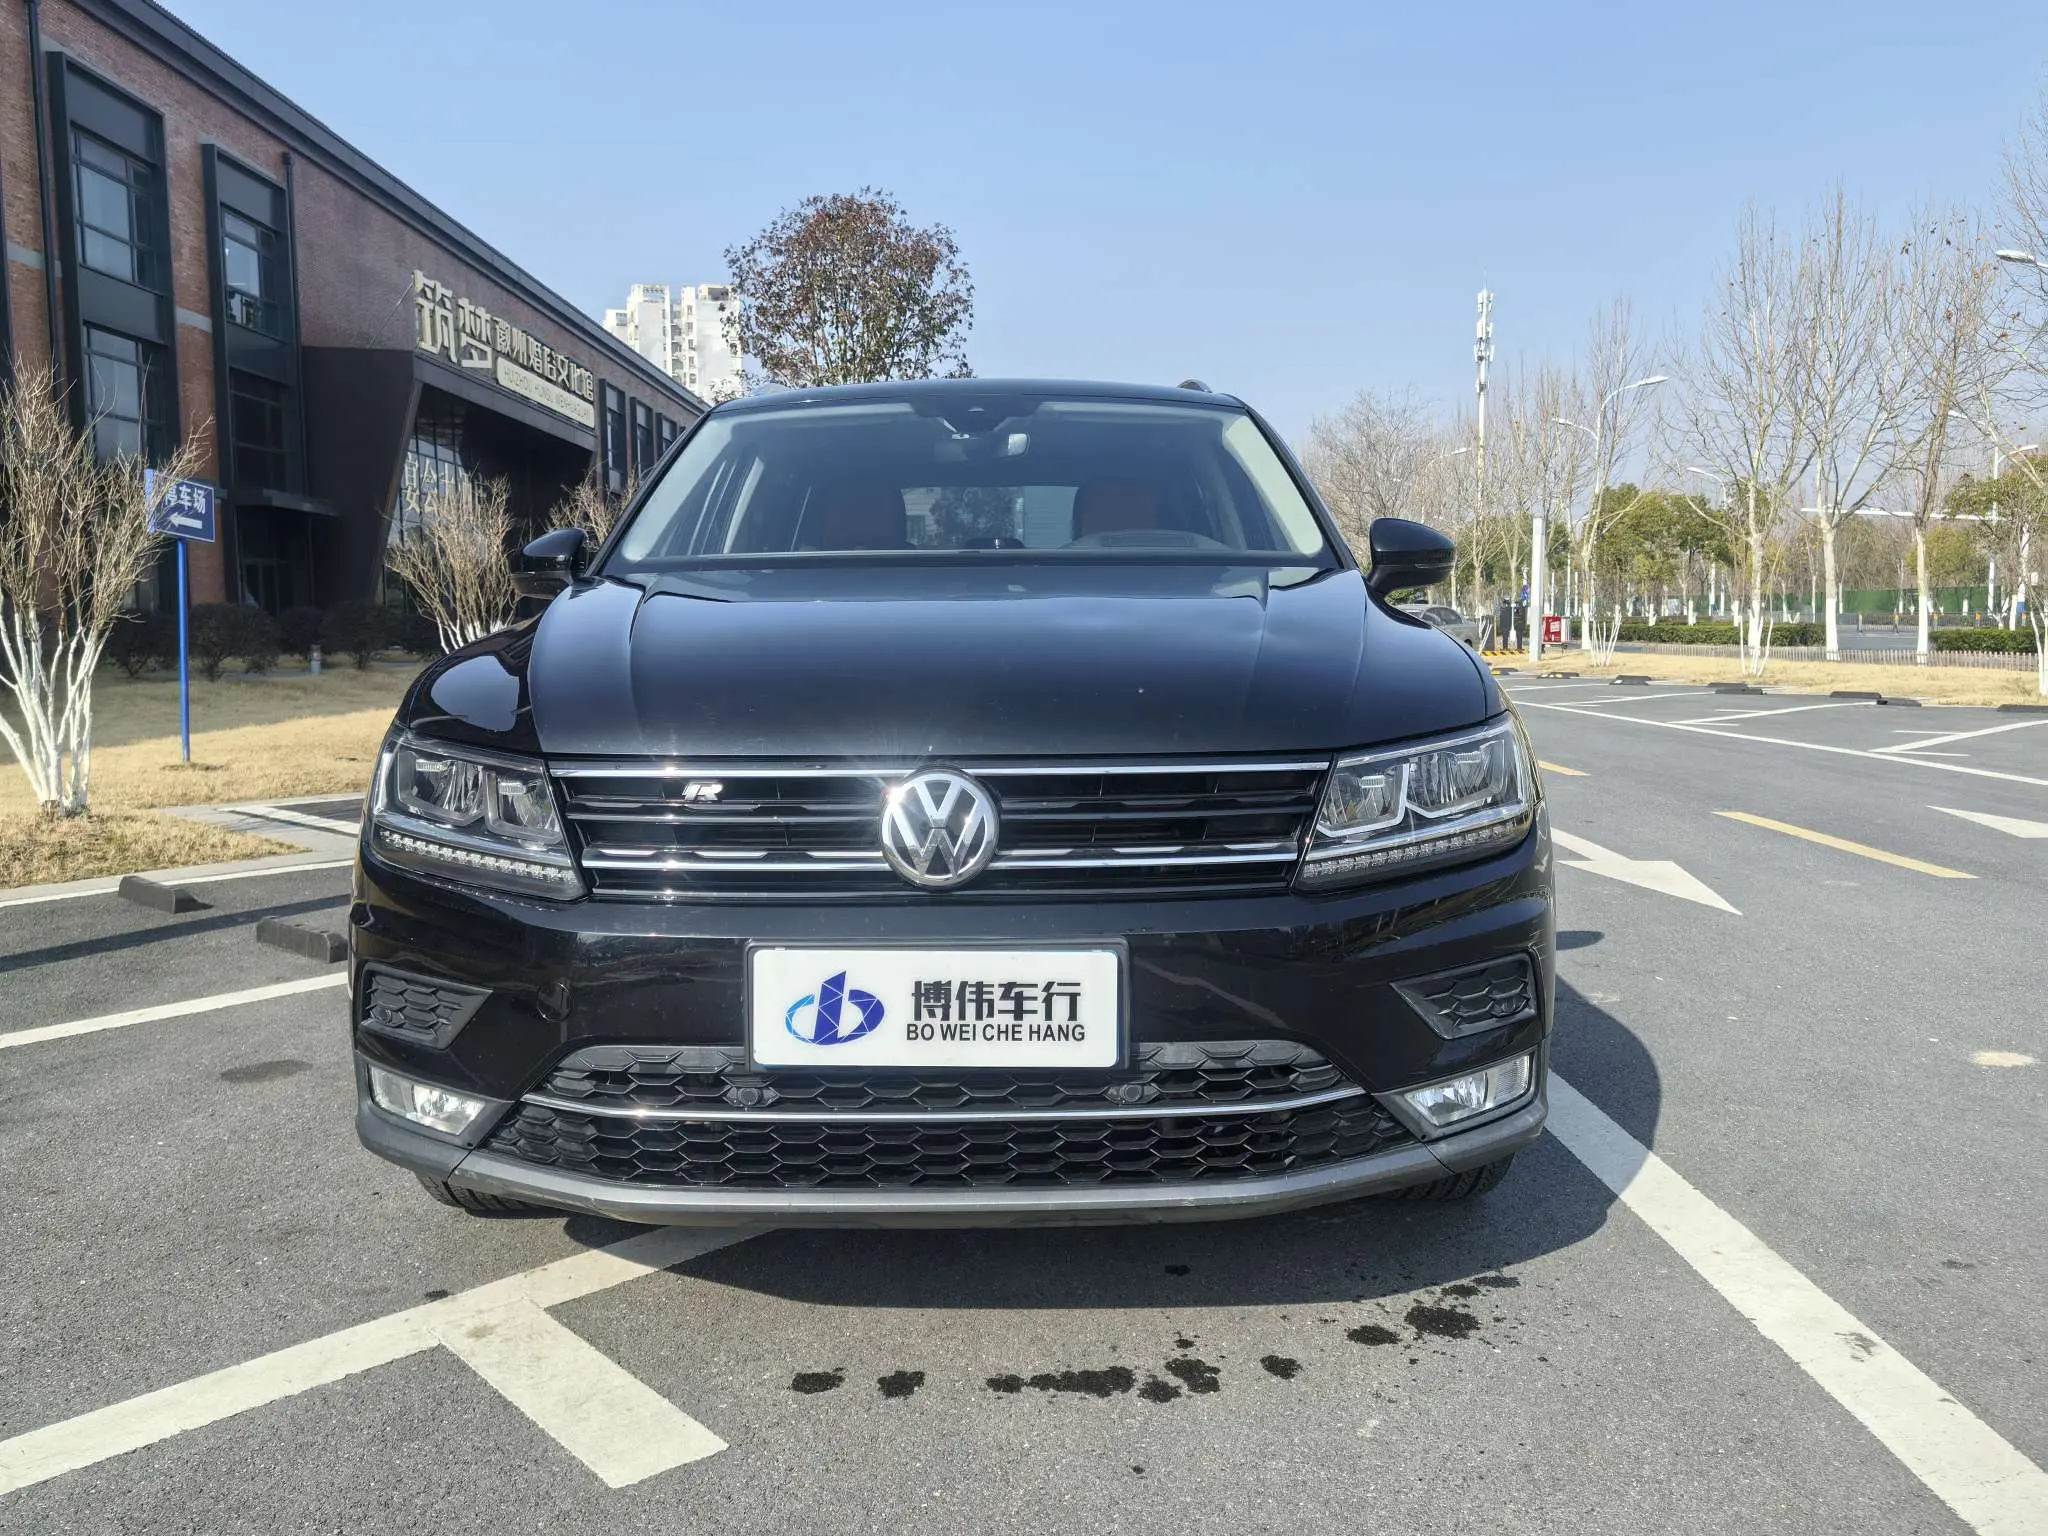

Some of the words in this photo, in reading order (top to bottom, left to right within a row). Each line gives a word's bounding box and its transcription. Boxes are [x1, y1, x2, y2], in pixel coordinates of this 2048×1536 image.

[412, 269, 493, 369] 筑梦
[494, 316, 594, 401] 徽州婚俗文化馆
[912, 980, 1081, 1022] 博伟车行
[906, 1024, 935, 1042] BO
[940, 1024, 976, 1042] WEI
[982, 1024, 1023, 1042] CHE
[1028, 1024, 1085, 1042] HANG
